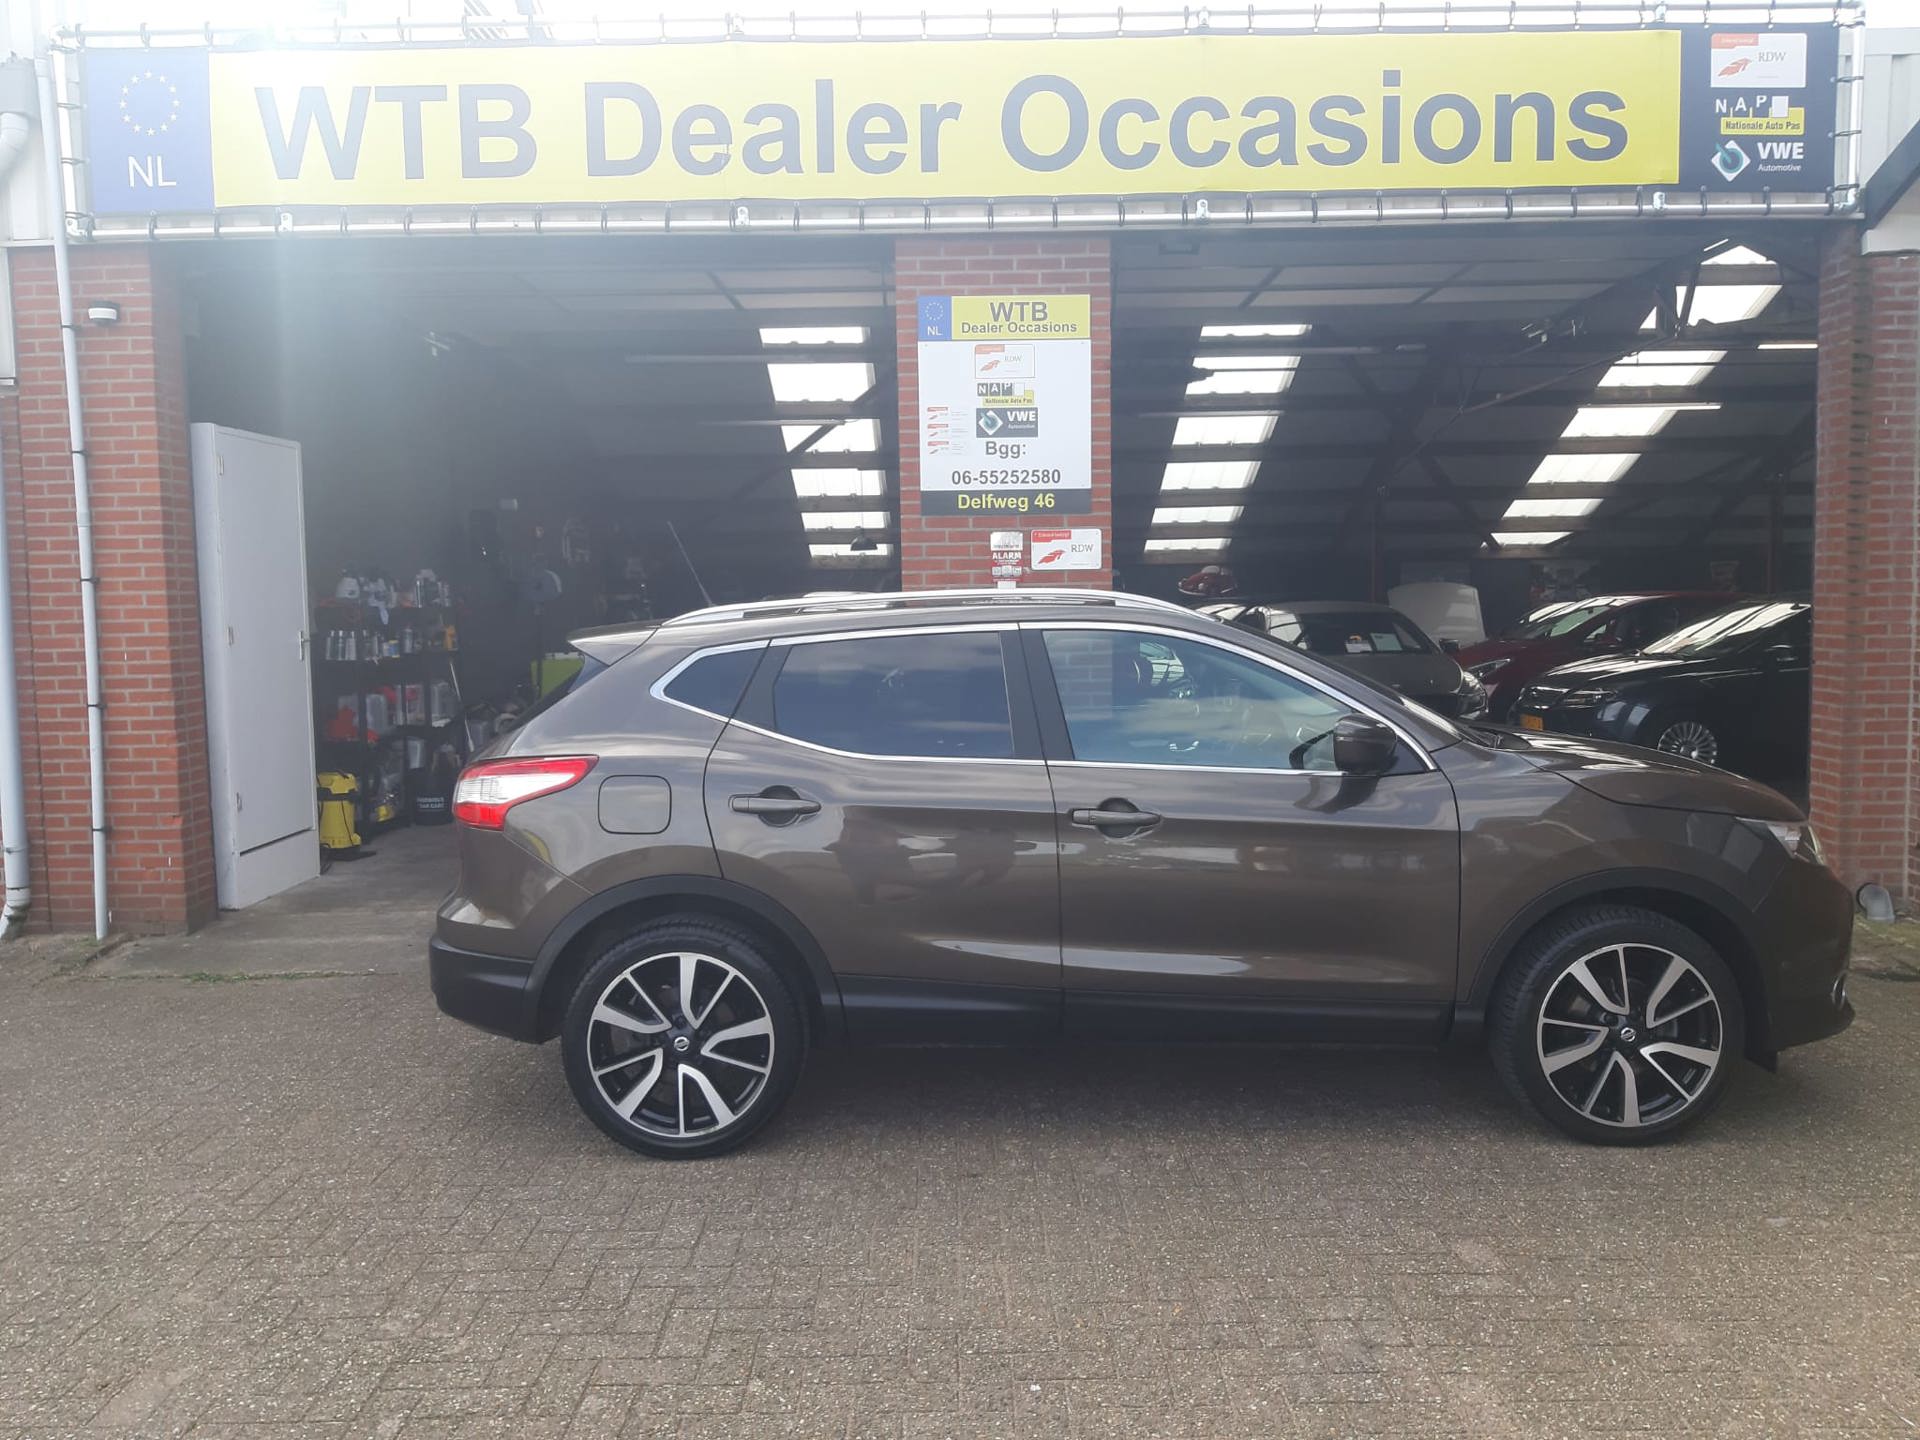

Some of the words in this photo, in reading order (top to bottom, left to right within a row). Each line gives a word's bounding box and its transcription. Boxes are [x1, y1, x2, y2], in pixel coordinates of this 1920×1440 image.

[1757, 51, 1786, 62] RDW
[254, 83, 537, 181] WTB
[584, 79, 962, 179] Dealer
[1001, 69, 1627, 172] Occasions
[1765, 121, 1784, 130] Auto
[1786, 121, 1801, 130] Pas
[1757, 142, 1804, 159] VWE
[127, 154, 177, 188] NL
[1758, 163, 1802, 172] Automotive
[989, 301, 1049, 322] WTB
[927, 325, 943, 337] NL
[961, 322, 1003, 334] Dealer
[1007, 321, 1078, 334] Occasions
[1006, 410, 1036, 422] VWE
[985, 440, 1027, 459] Bgg:
[951, 469, 1061, 485] 06-55252580
[958, 494, 1029, 512] Delfweg
[1034, 494, 1055, 508] 46
[1071, 544, 1094, 553] RDW
[992, 551, 1021, 560] ALARM
